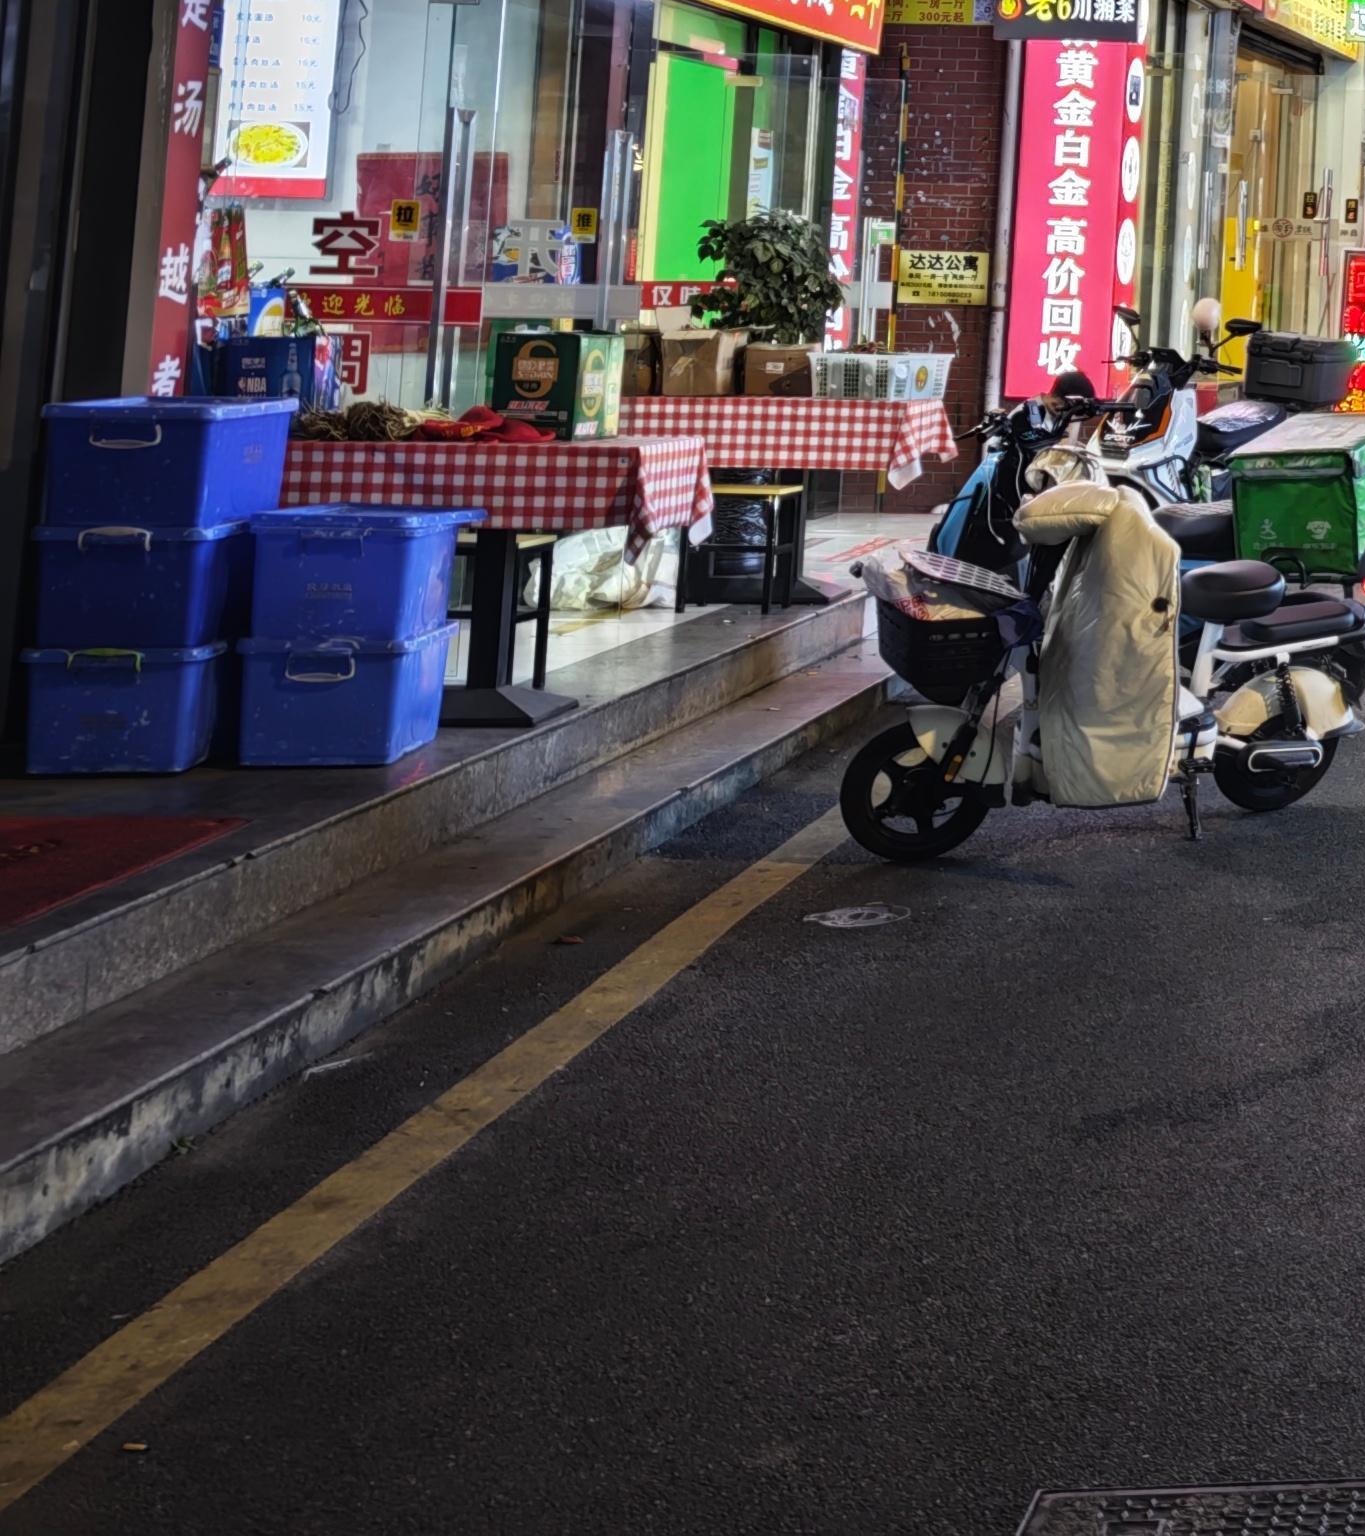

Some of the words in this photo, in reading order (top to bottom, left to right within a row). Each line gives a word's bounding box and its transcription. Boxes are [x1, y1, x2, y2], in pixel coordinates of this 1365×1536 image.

[919, 11, 965, 23] 300元起
[396, 204, 414, 224] 拉
[1037, 40, 1099, 377] 黄金白金高价回收
[575, 212, 593, 229] 推
[908, 253, 979, 272] 达达公寓
[246, 377, 267, 393] NBA
